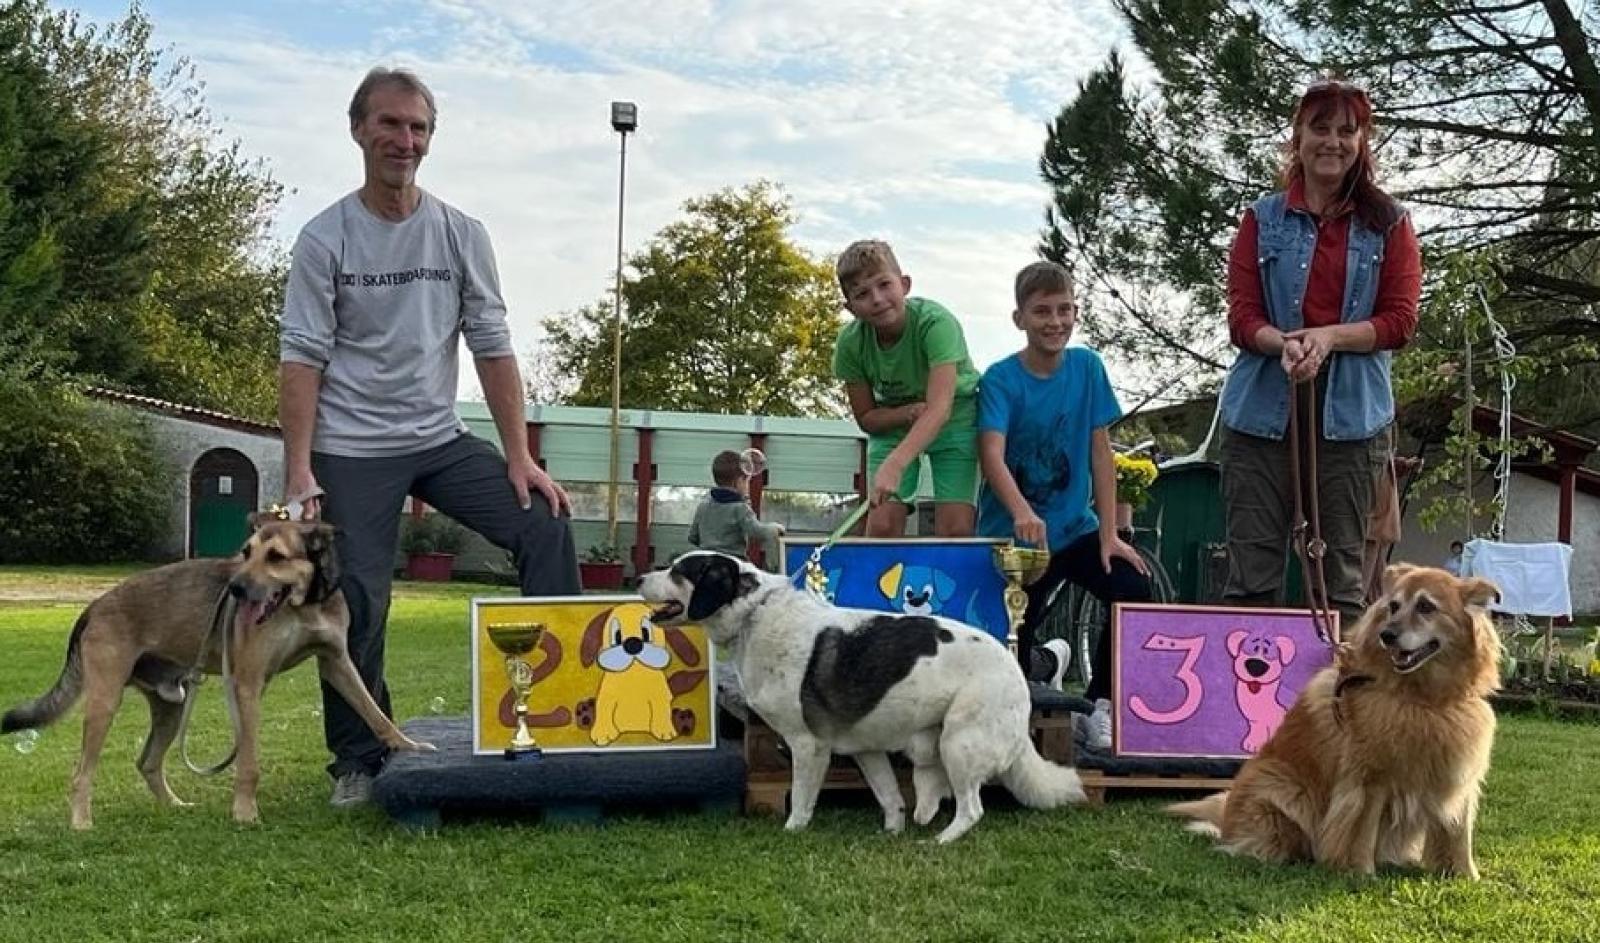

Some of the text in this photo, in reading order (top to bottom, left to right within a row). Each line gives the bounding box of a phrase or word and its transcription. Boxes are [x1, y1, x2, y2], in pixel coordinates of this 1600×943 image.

[362, 267, 451, 286] SKATEBOARDING
[498, 627, 572, 728] 2
[1128, 632, 1207, 726] 3
